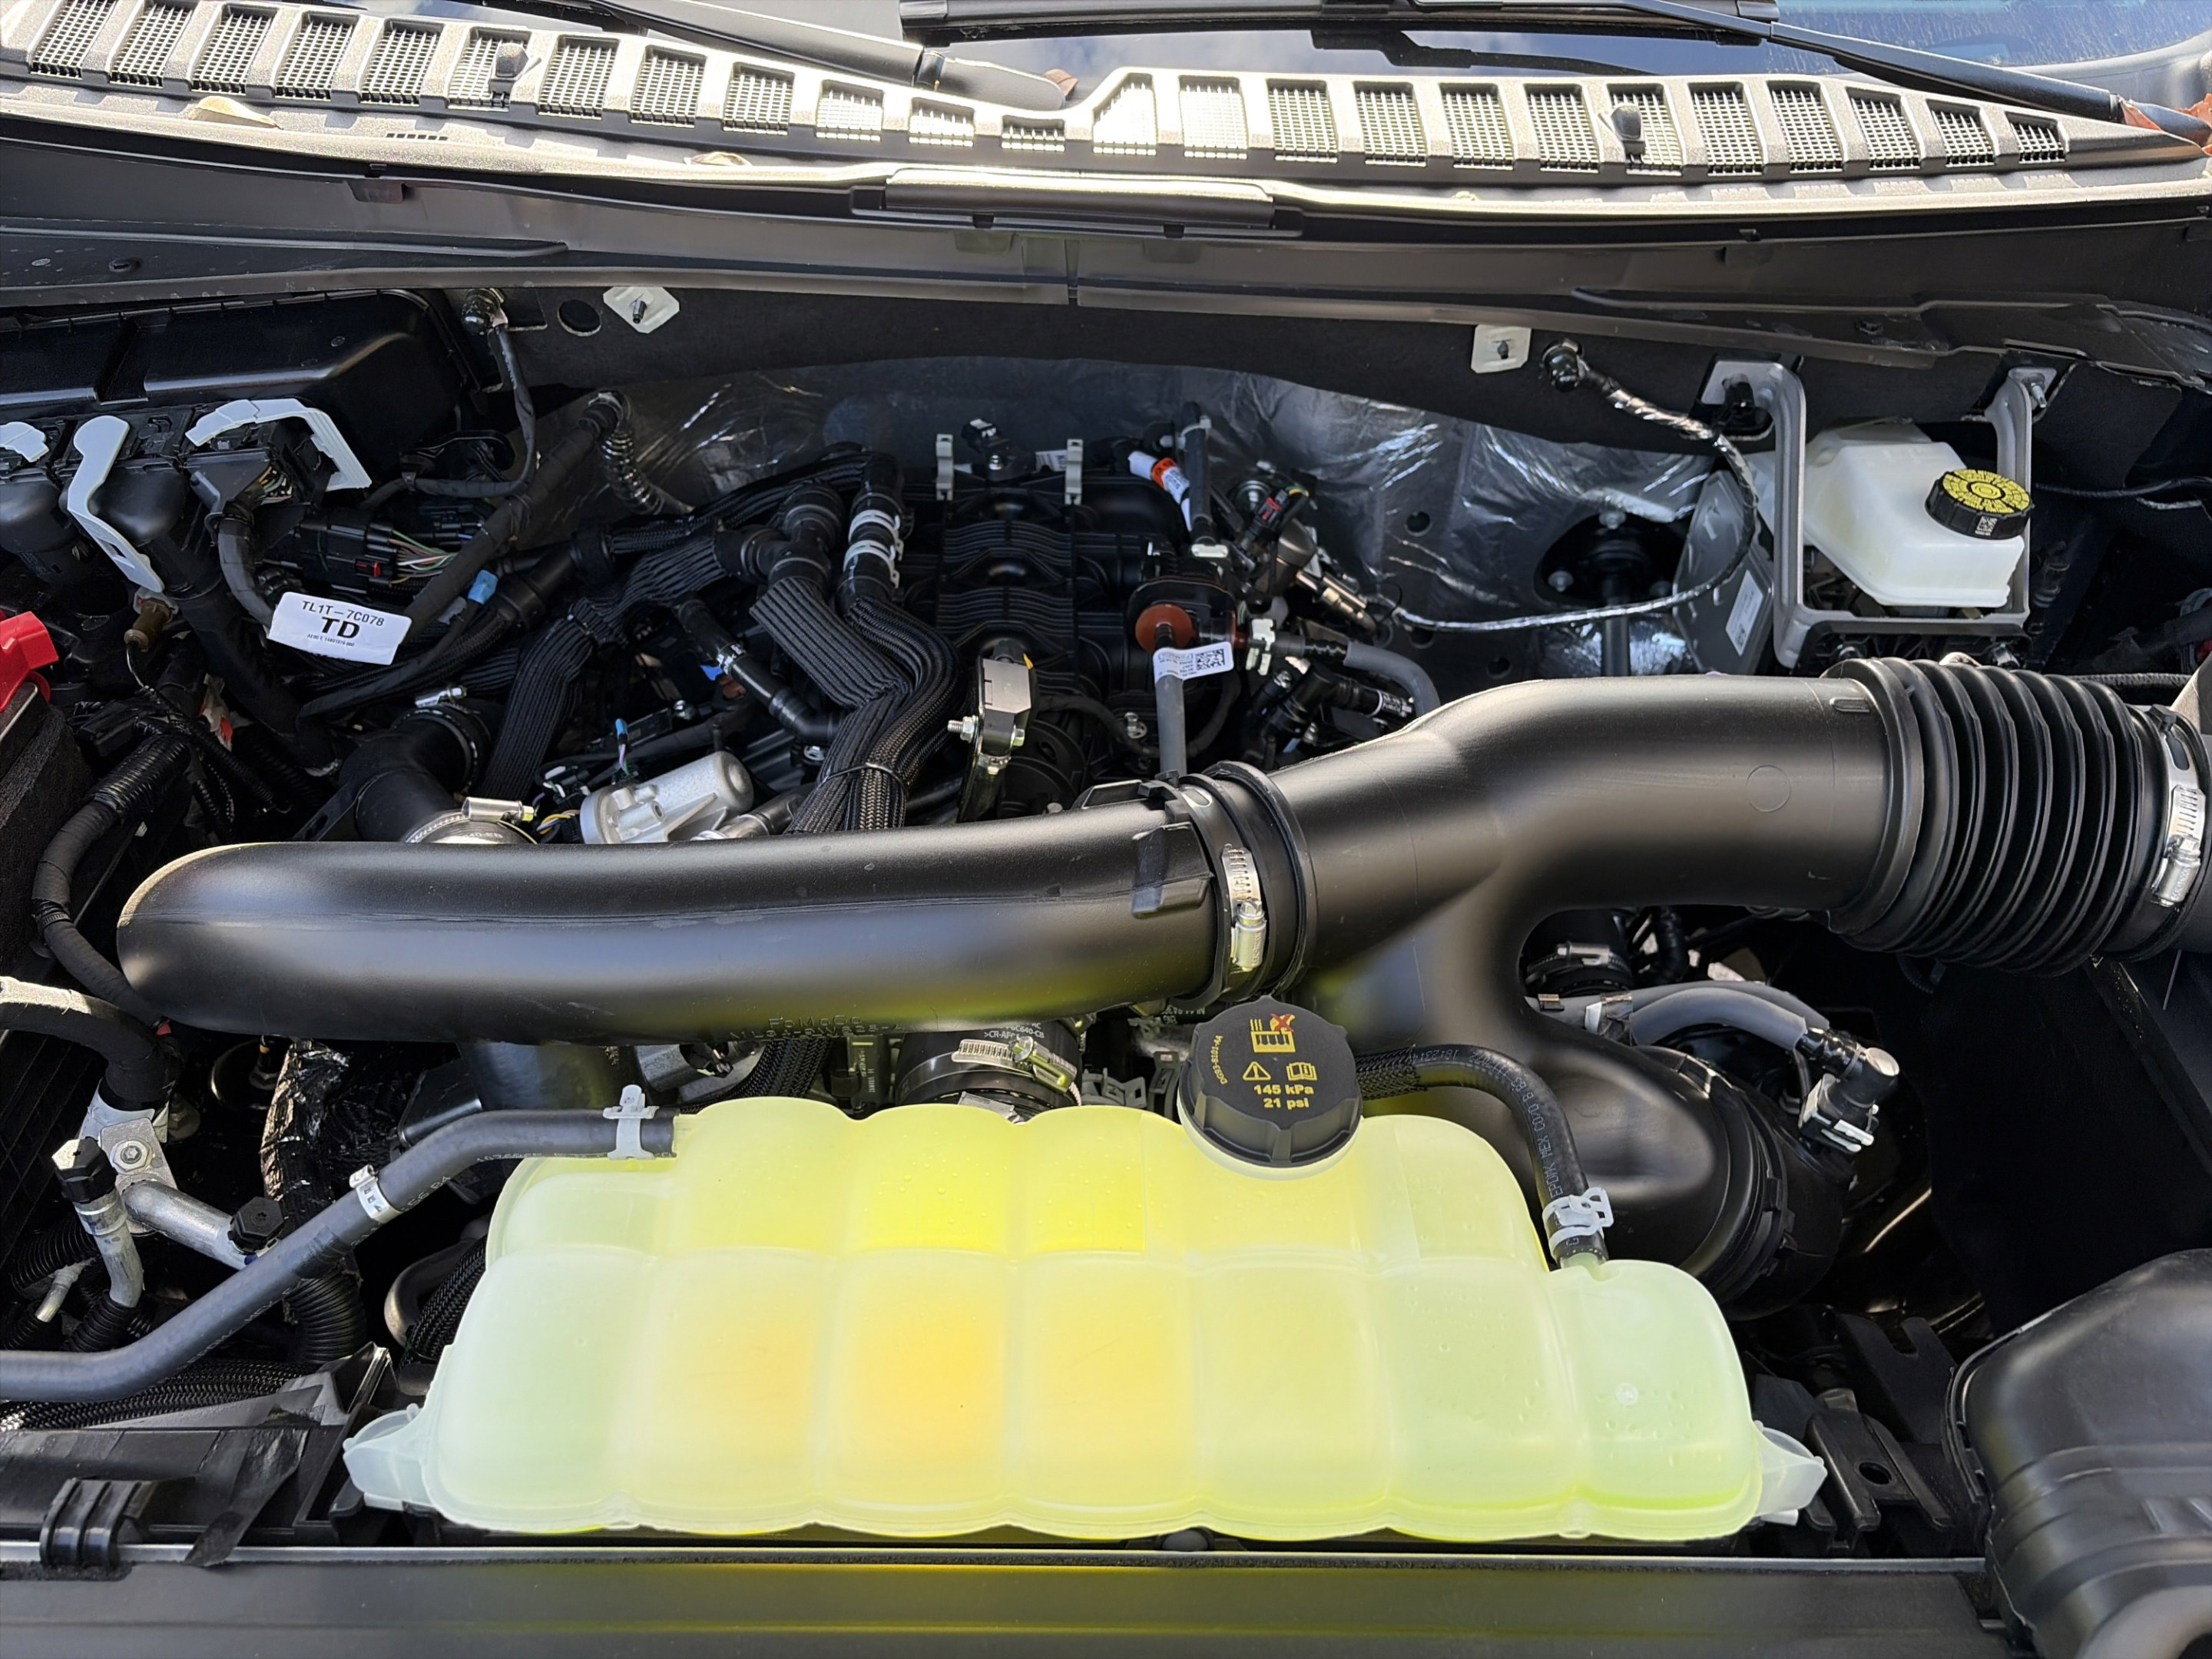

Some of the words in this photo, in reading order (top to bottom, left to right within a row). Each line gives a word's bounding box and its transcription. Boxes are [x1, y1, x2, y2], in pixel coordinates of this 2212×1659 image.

[321, 617, 360, 639] TD
[768, 1015, 861, 1028] FoMoCo
[1253, 1084, 1282, 1095] 145
[1285, 1084, 1314, 1095] kPa
[1263, 1098, 1282, 1108] 21
[1286, 1098, 1310, 1111] psi
[1537, 1134, 1553, 1160] MEX
